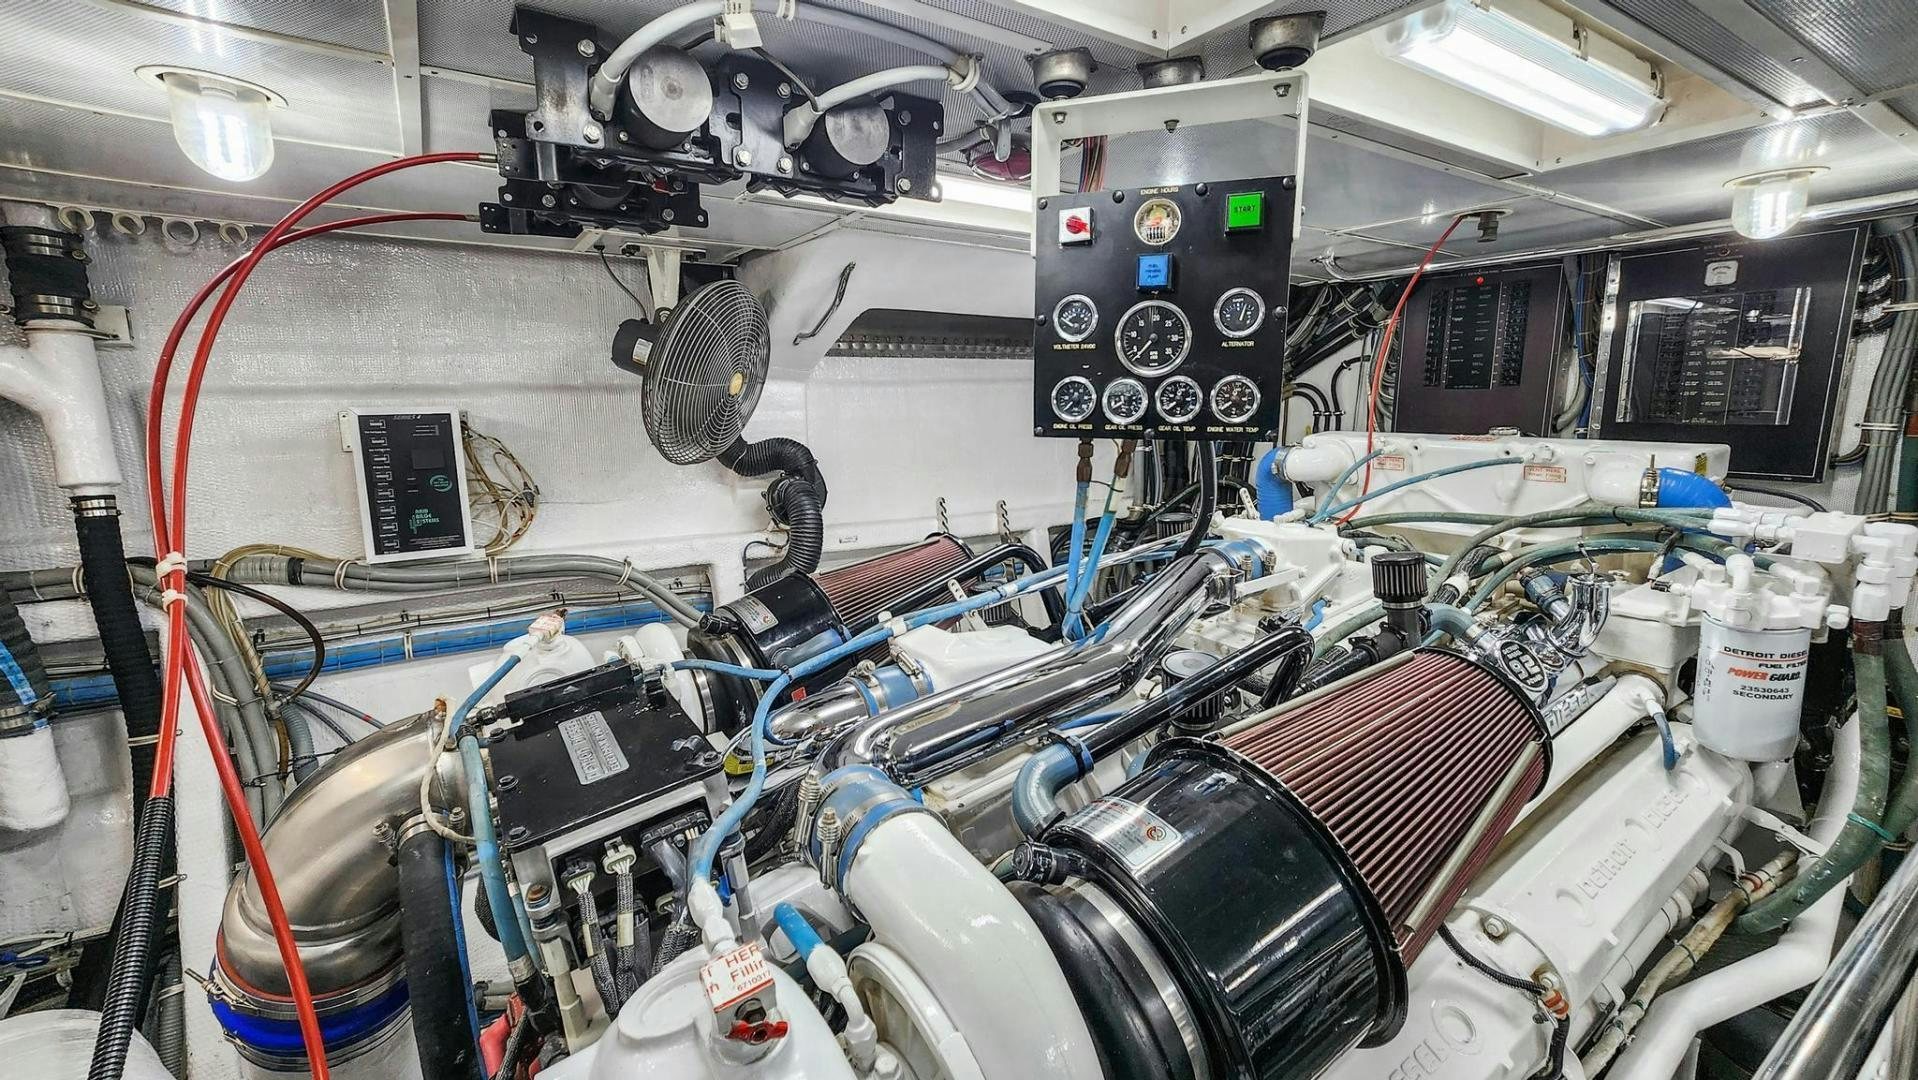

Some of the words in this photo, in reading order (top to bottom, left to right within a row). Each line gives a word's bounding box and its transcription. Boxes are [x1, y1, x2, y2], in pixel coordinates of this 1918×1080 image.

[1234, 205, 1255, 213] START
[1723, 646, 1775, 659] DETROIT
[1780, 649, 1808, 659] DIESE
[1508, 654, 1541, 680] 92
[1727, 667, 1769, 680] POWER
[1732, 690, 1794, 700] SECONDARY
[1740, 684, 1790, 694] 23530643
[724, 943, 760, 968] HER
